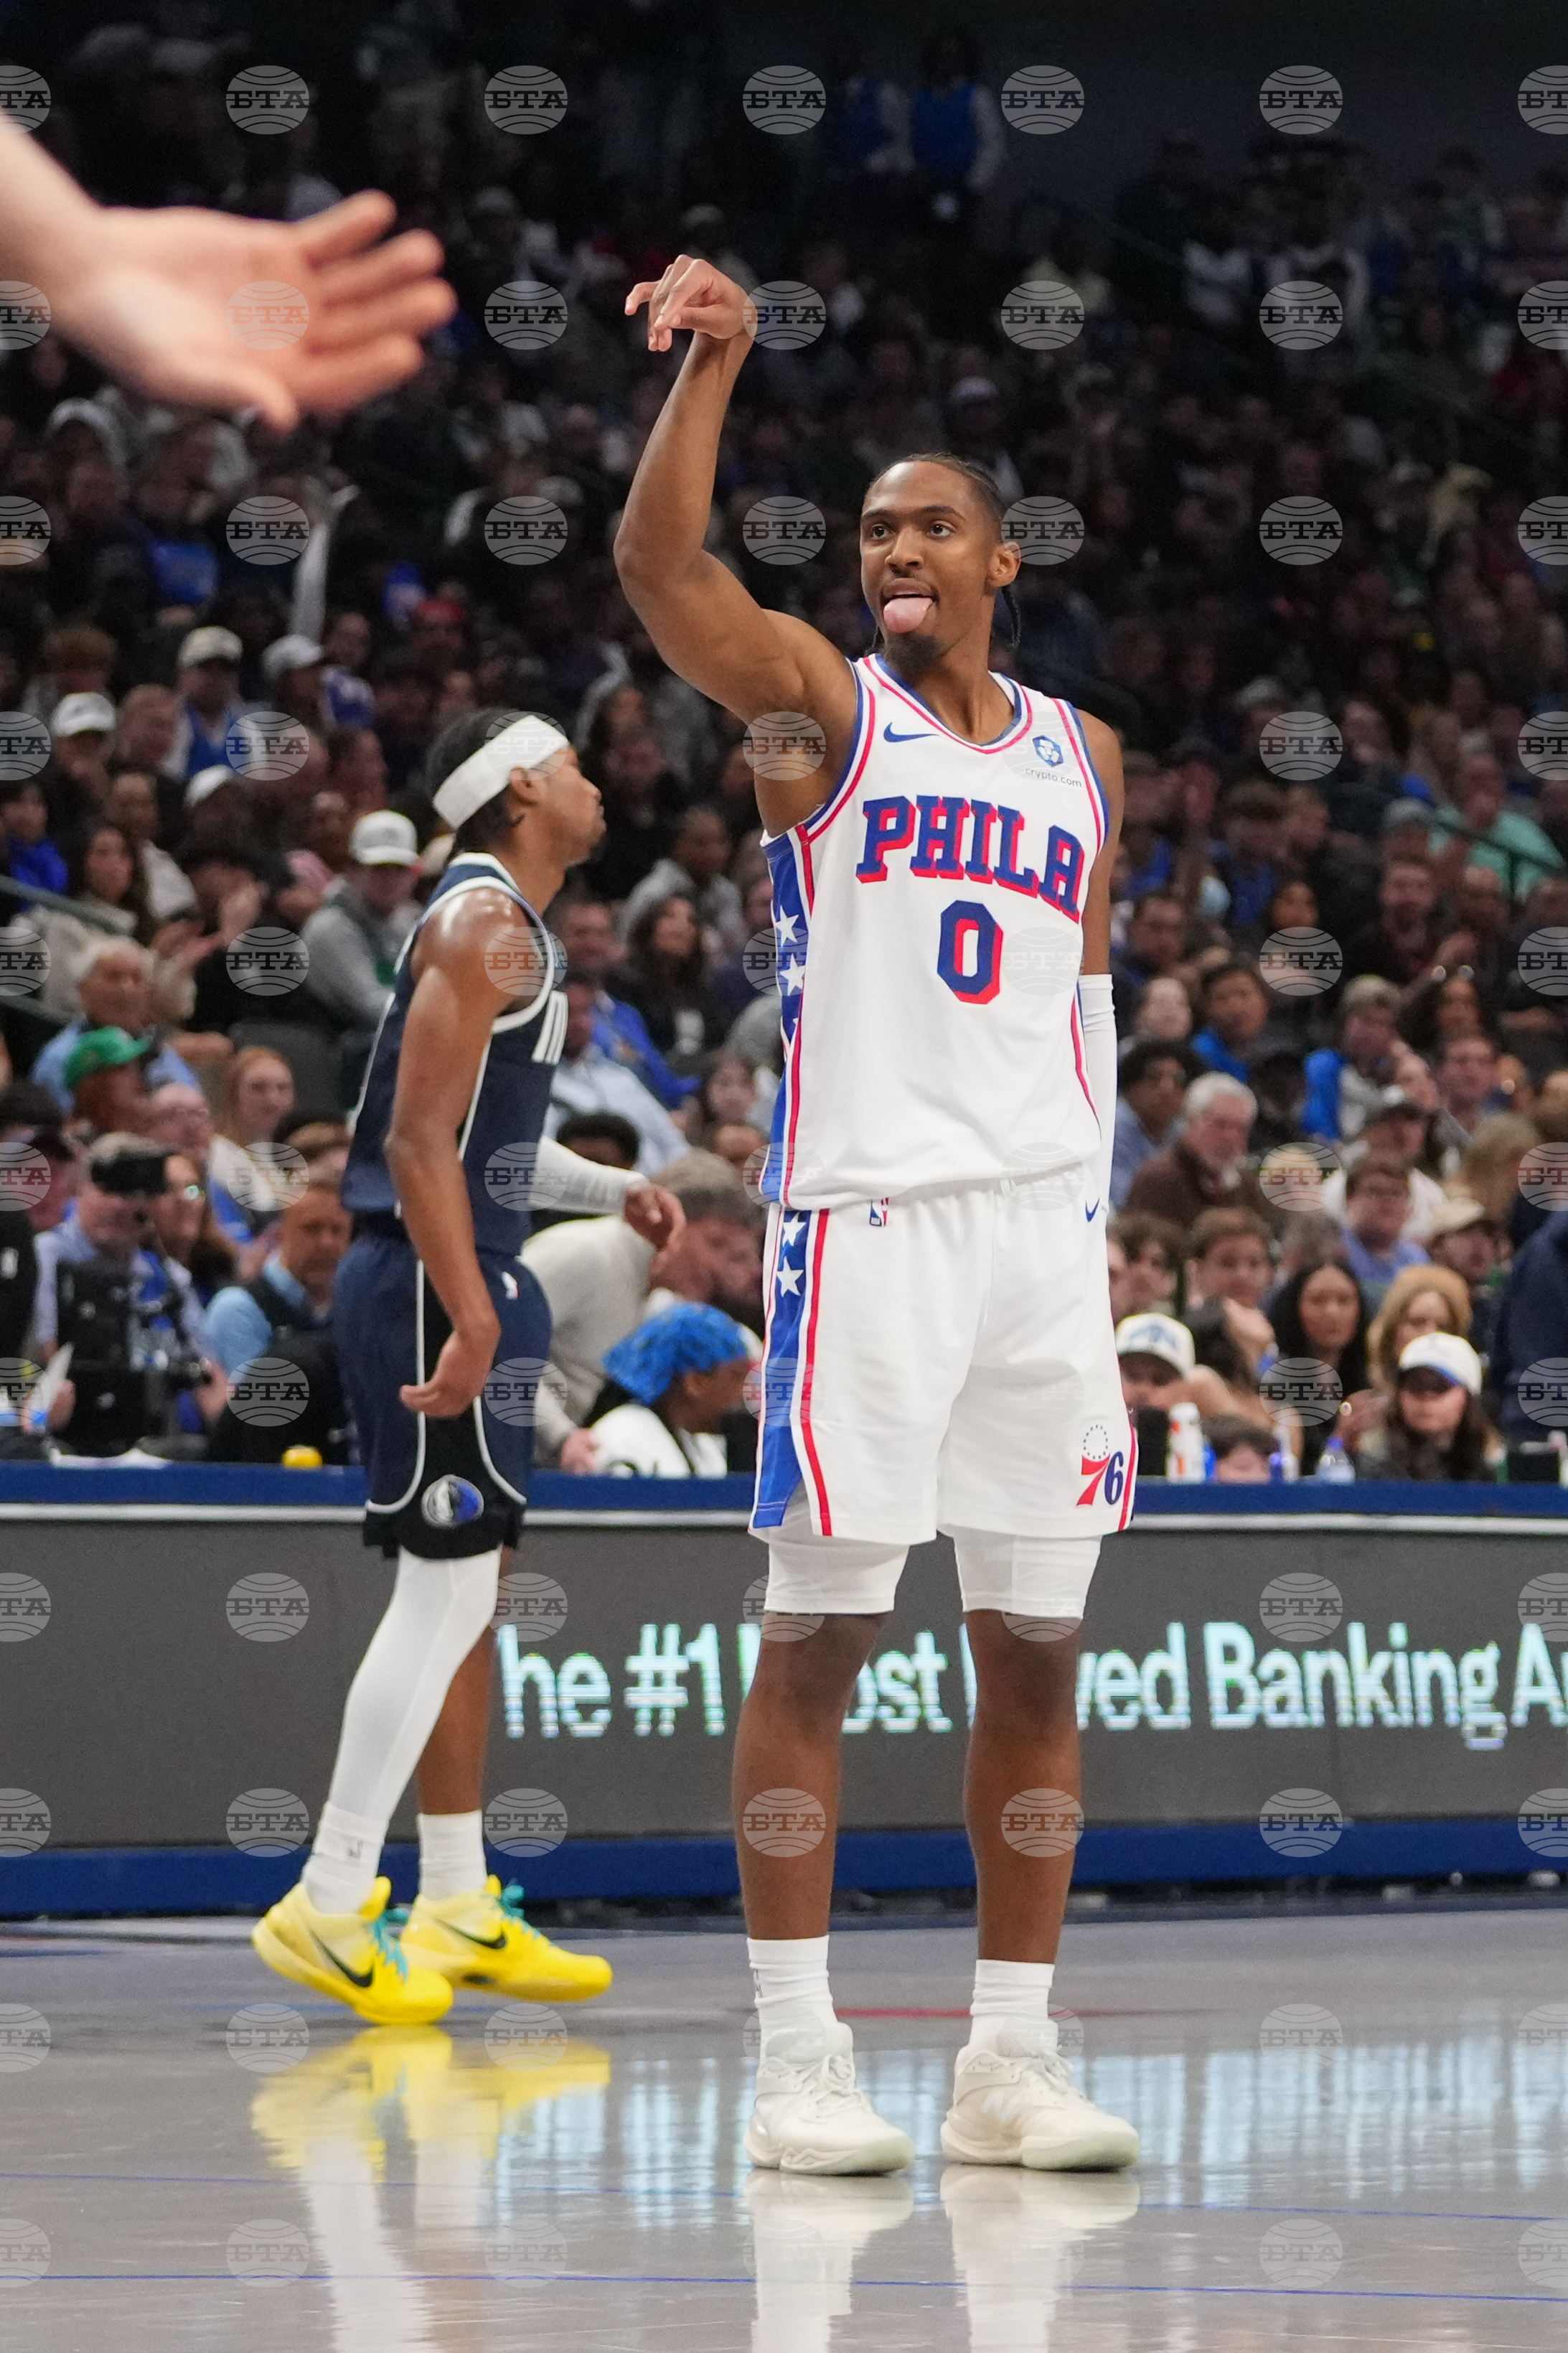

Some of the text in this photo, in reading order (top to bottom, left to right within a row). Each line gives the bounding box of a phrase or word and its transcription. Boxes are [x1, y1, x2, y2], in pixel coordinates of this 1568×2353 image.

[1025, 768, 1082, 788] crypto.com
[855, 795, 1085, 925] PHILA
[936, 899, 1004, 1005] 0
[1076, 1450, 1124, 1506] 76
[498, 1623, 612, 1738] he
[622, 1623, 726, 1737] #1
[1203, 1622, 1508, 1750] Banking
[1511, 1623, 1568, 1727] A
